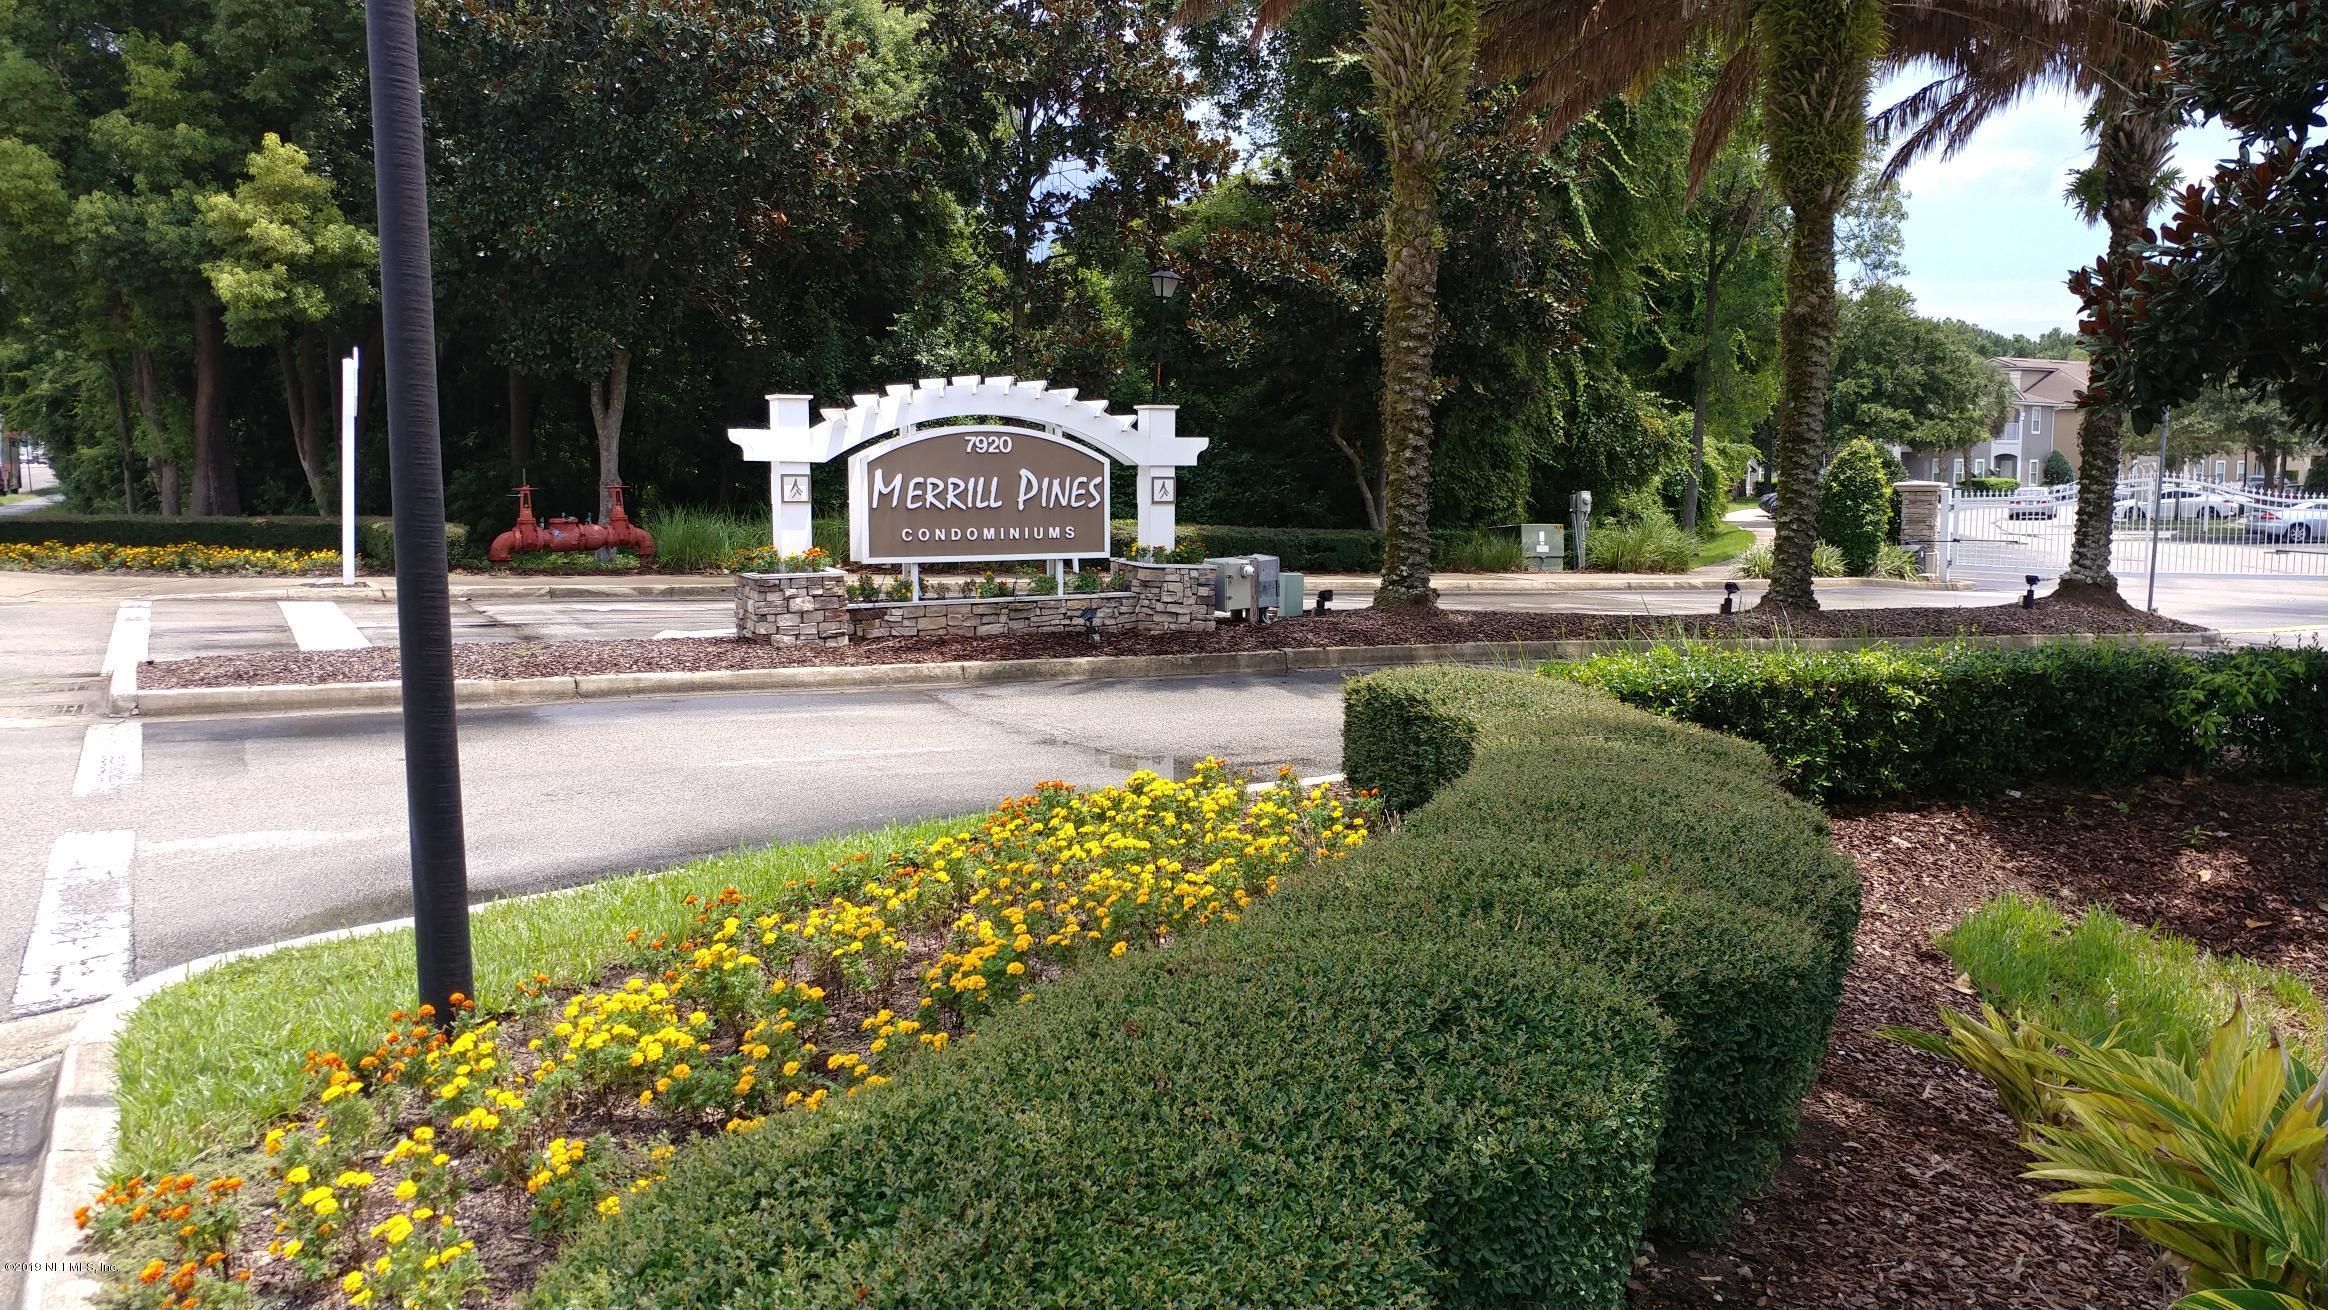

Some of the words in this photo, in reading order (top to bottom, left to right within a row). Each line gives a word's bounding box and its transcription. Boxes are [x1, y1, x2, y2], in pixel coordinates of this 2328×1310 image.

[964, 436, 1013, 454] 7920
[871, 468, 1003, 511] MERRILL
[1016, 467, 1103, 512] PINES
[901, 526, 1076, 542] CONDOMINIUMS
